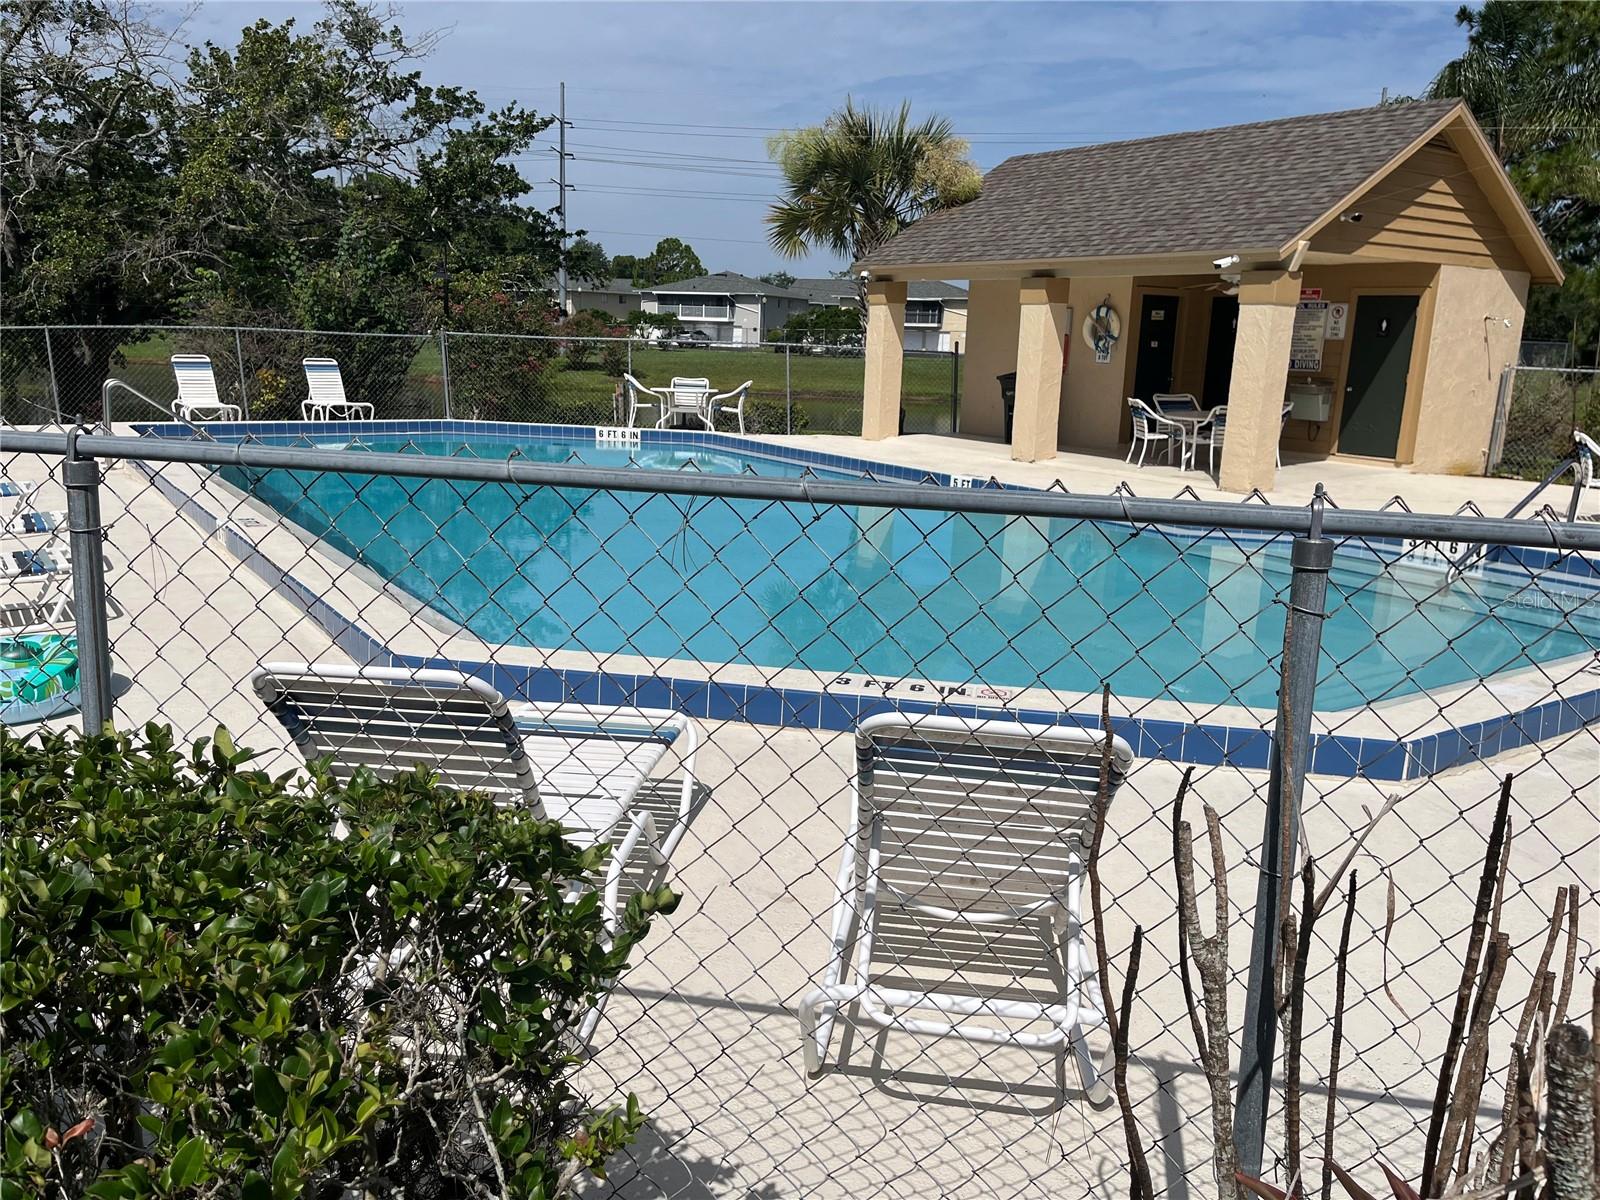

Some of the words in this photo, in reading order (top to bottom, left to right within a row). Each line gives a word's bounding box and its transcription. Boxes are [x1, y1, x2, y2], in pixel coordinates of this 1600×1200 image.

[1294, 360, 1319, 369] DIVING
[598, 430, 604, 438] 6
[621, 431, 626, 439] 6
[953, 478, 958, 487] 5
[1449, 541, 1458, 554] 6
[835, 677, 852, 685] 3
[909, 684, 925, 692] 6
